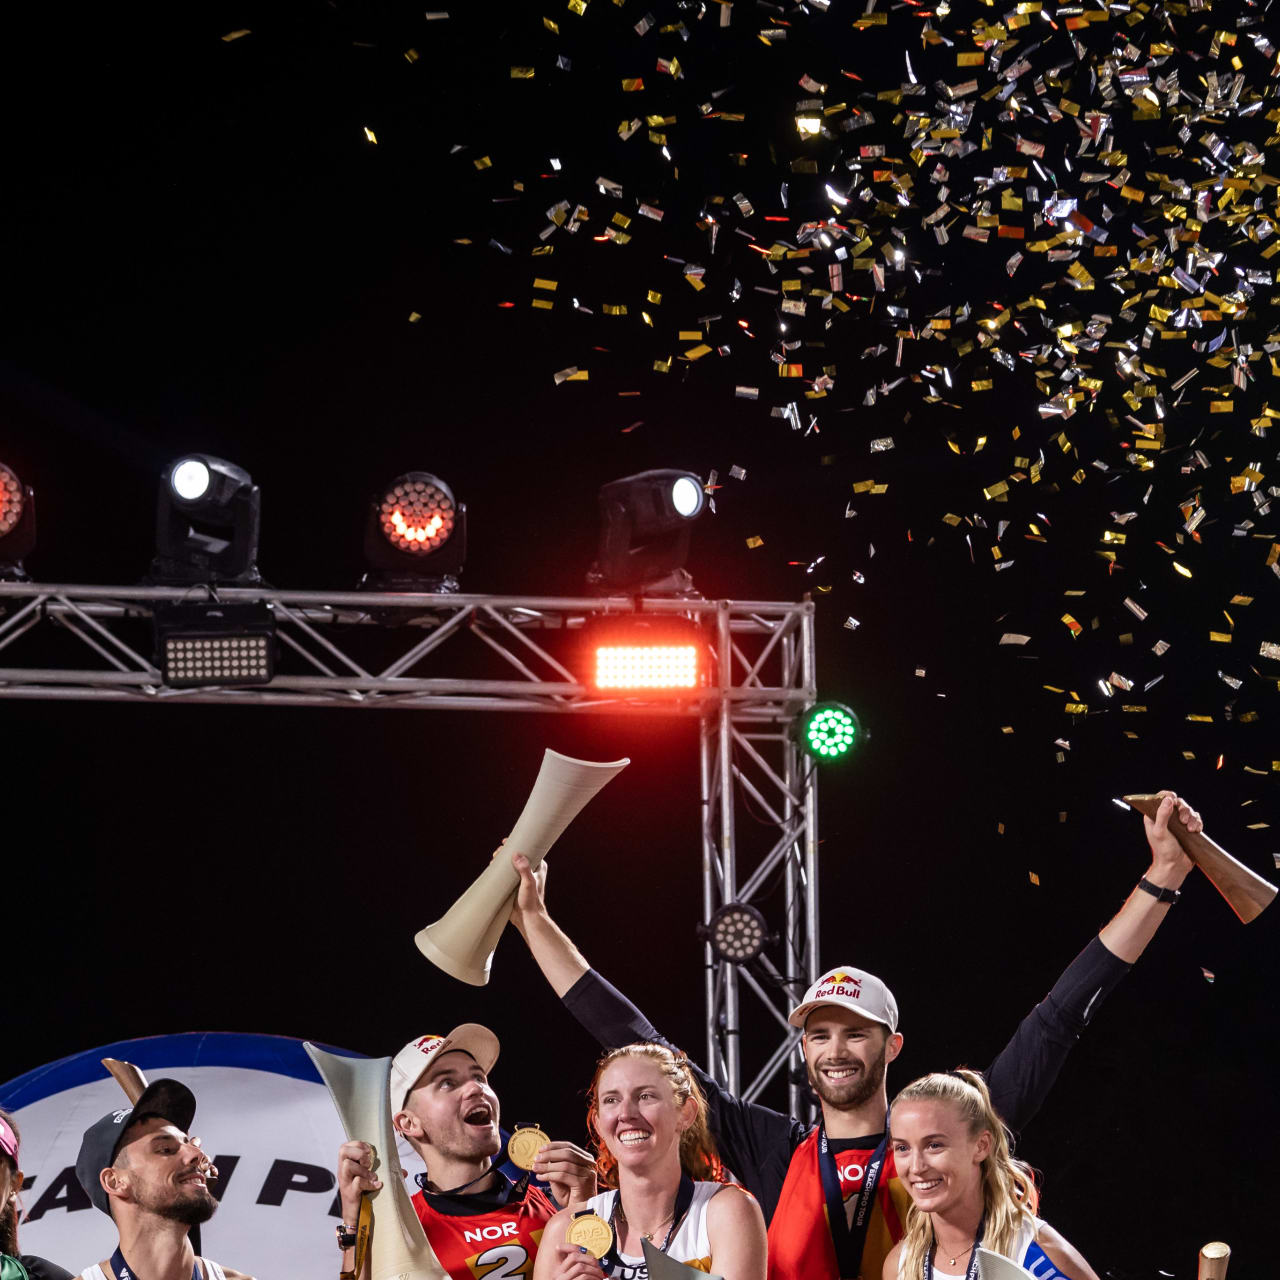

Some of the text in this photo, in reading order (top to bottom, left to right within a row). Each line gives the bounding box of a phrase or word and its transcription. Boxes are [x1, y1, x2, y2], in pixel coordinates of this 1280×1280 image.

[815, 985, 861, 1000] Red Bull
[837, 1164, 867, 1183] NO
[856, 1168, 876, 1227] BEACH PRO TOUR
[464, 1221, 520, 1244] NOR
[574, 1228, 604, 1242] FIVB
